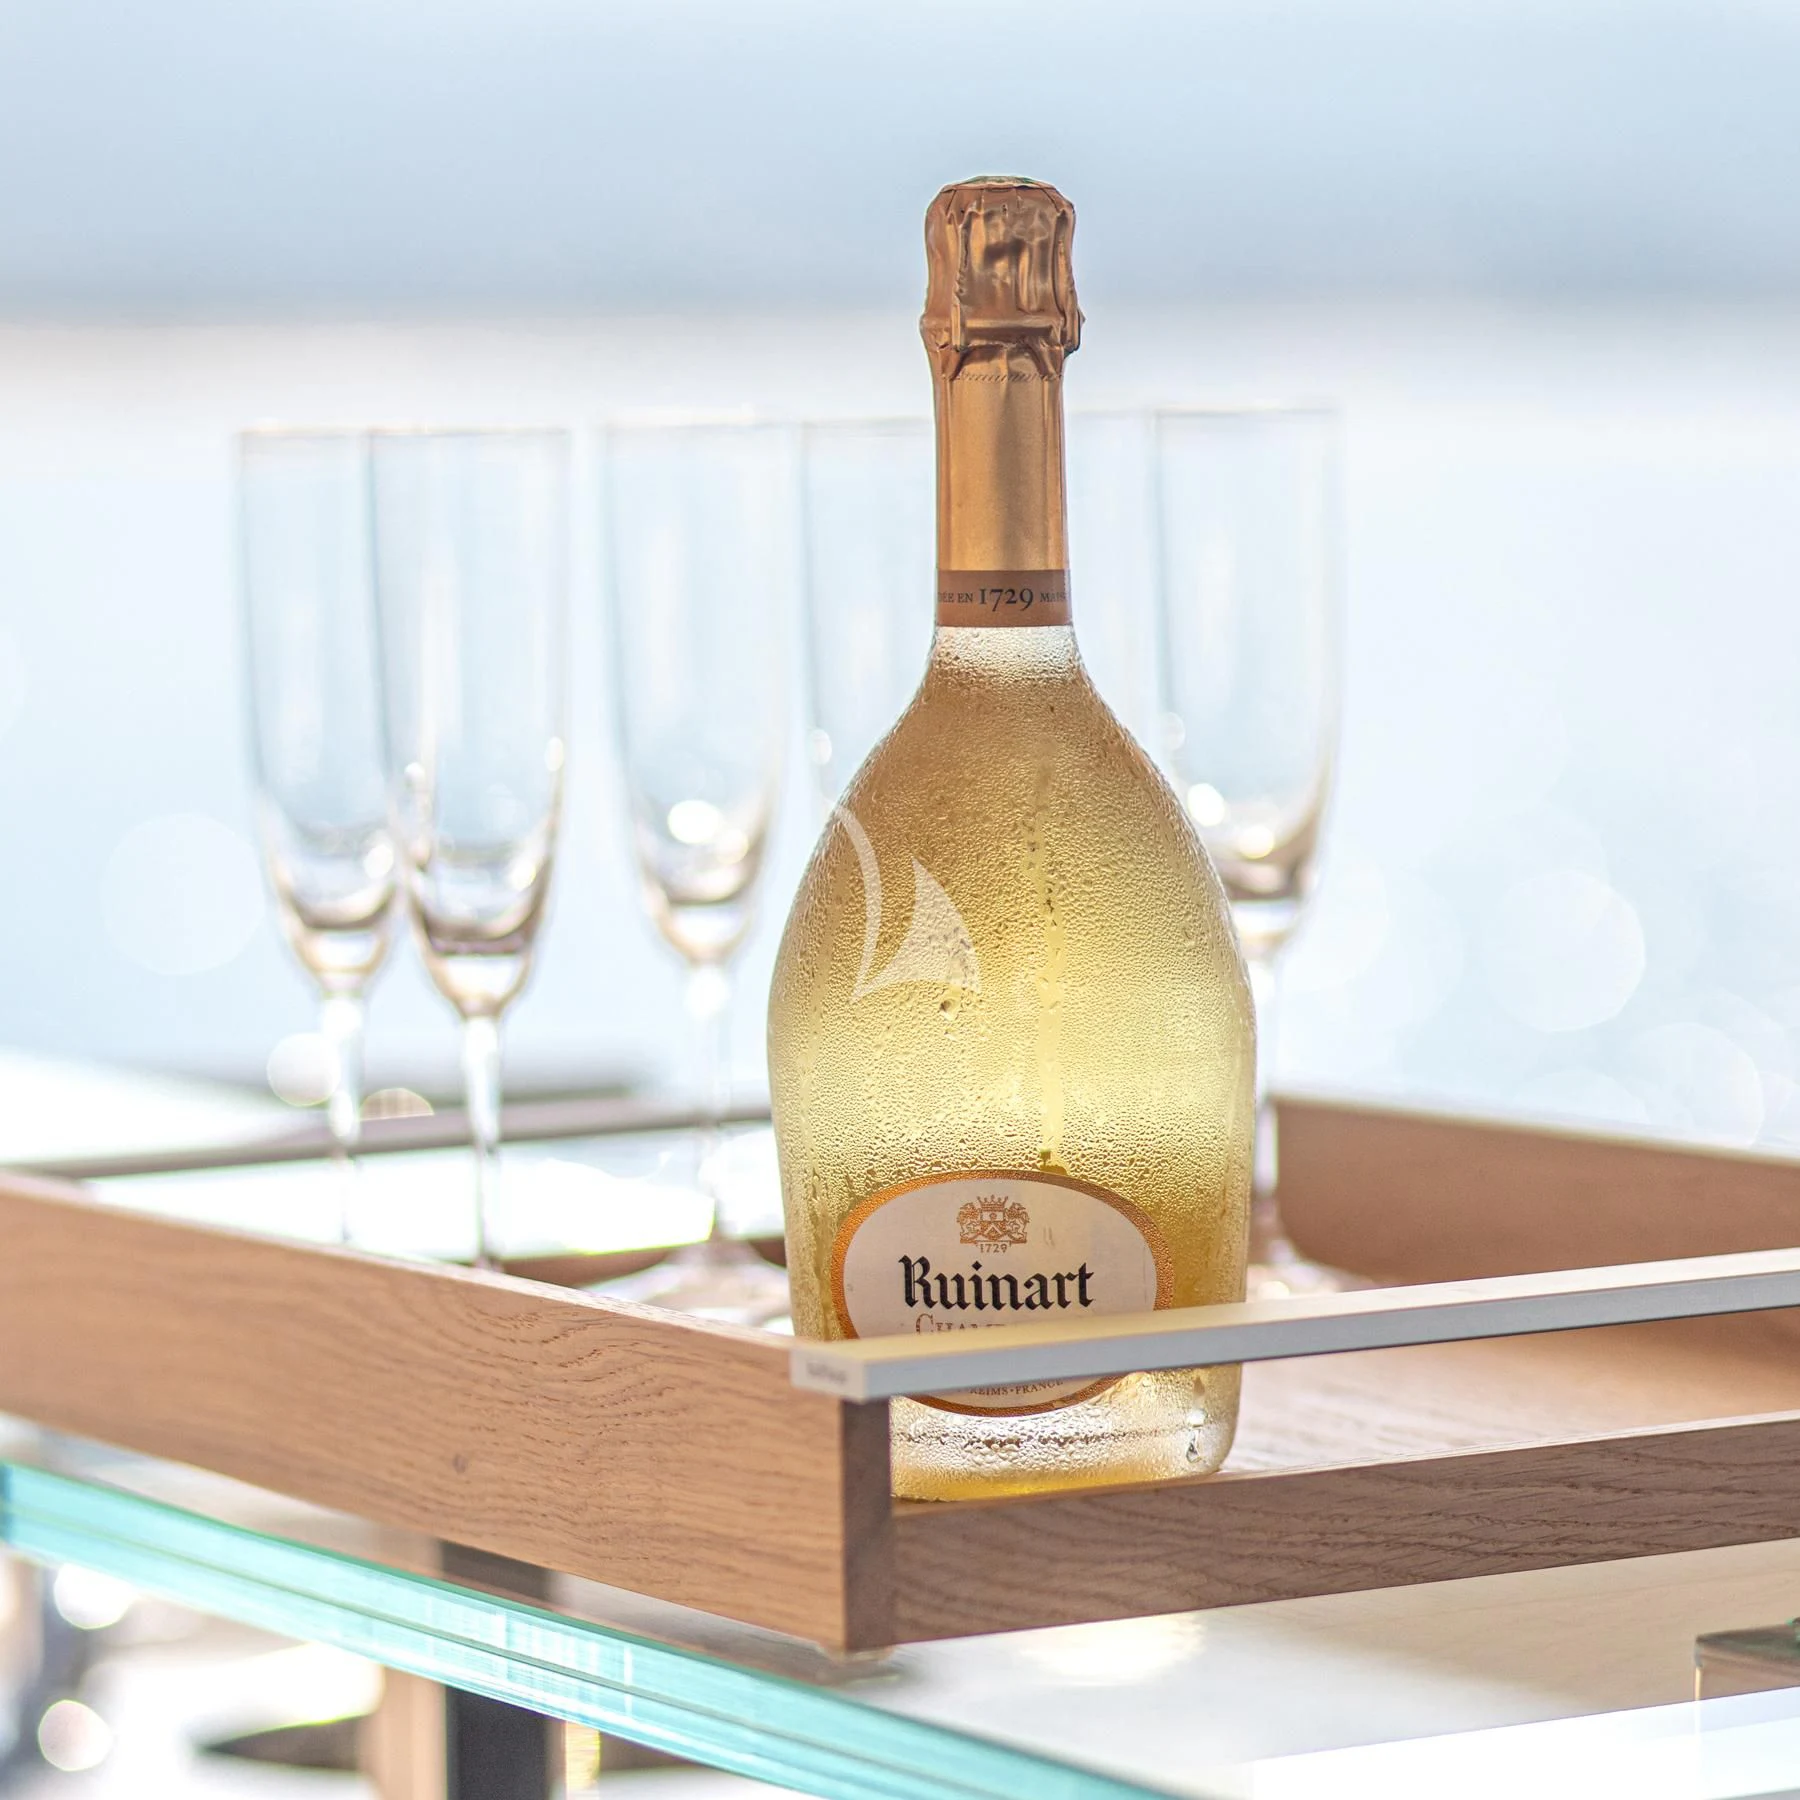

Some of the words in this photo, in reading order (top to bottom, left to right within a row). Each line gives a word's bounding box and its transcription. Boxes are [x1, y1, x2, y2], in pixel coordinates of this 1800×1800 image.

[957, 592, 973, 603] EN
[979, 588, 1034, 612] 1729
[980, 1243, 1008, 1253] 1729
[898, 1254, 1095, 1311] Ruinart
